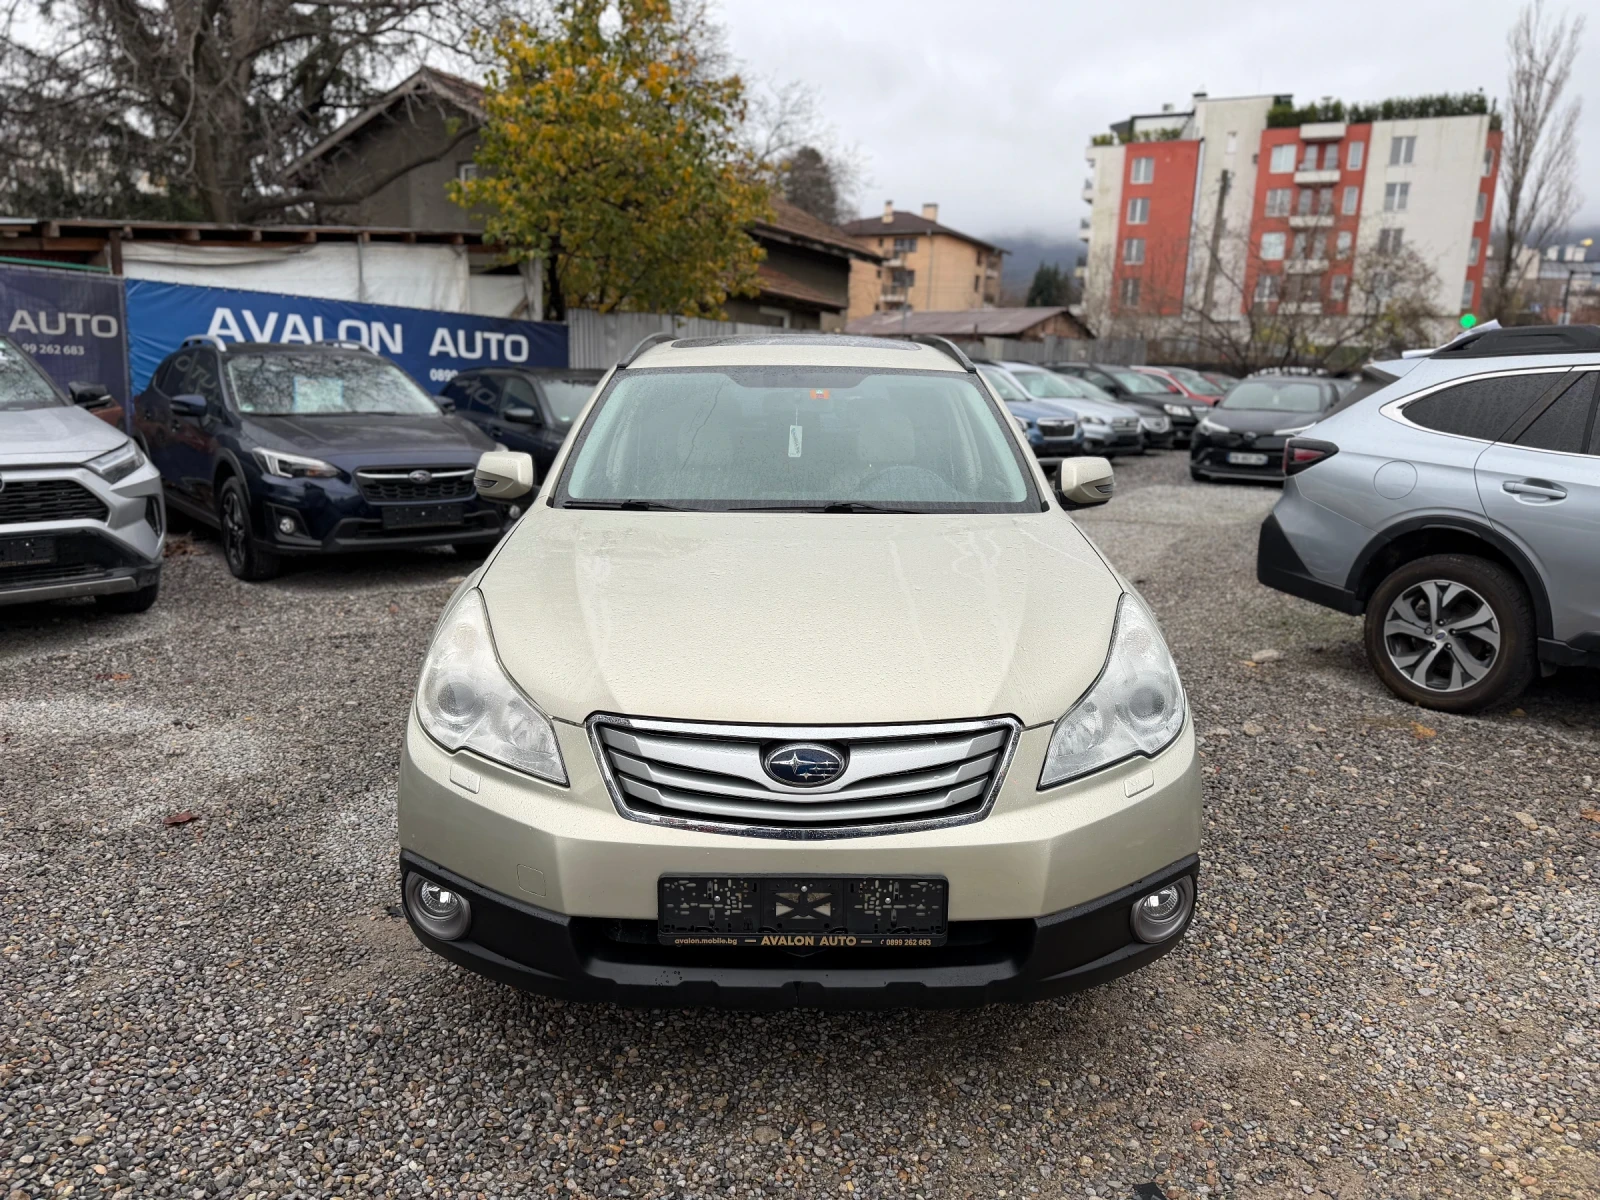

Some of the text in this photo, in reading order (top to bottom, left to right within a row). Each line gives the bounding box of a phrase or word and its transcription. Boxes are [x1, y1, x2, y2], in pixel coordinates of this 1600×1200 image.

[8, 309, 119, 338] AUTO
[207, 307, 529, 363] AVALON AUTO
[21, 342, 85, 356] 99 262 683
[674, 935, 932, 946] avalon.mobile.bg AVALON AUTO 0899 262 683
